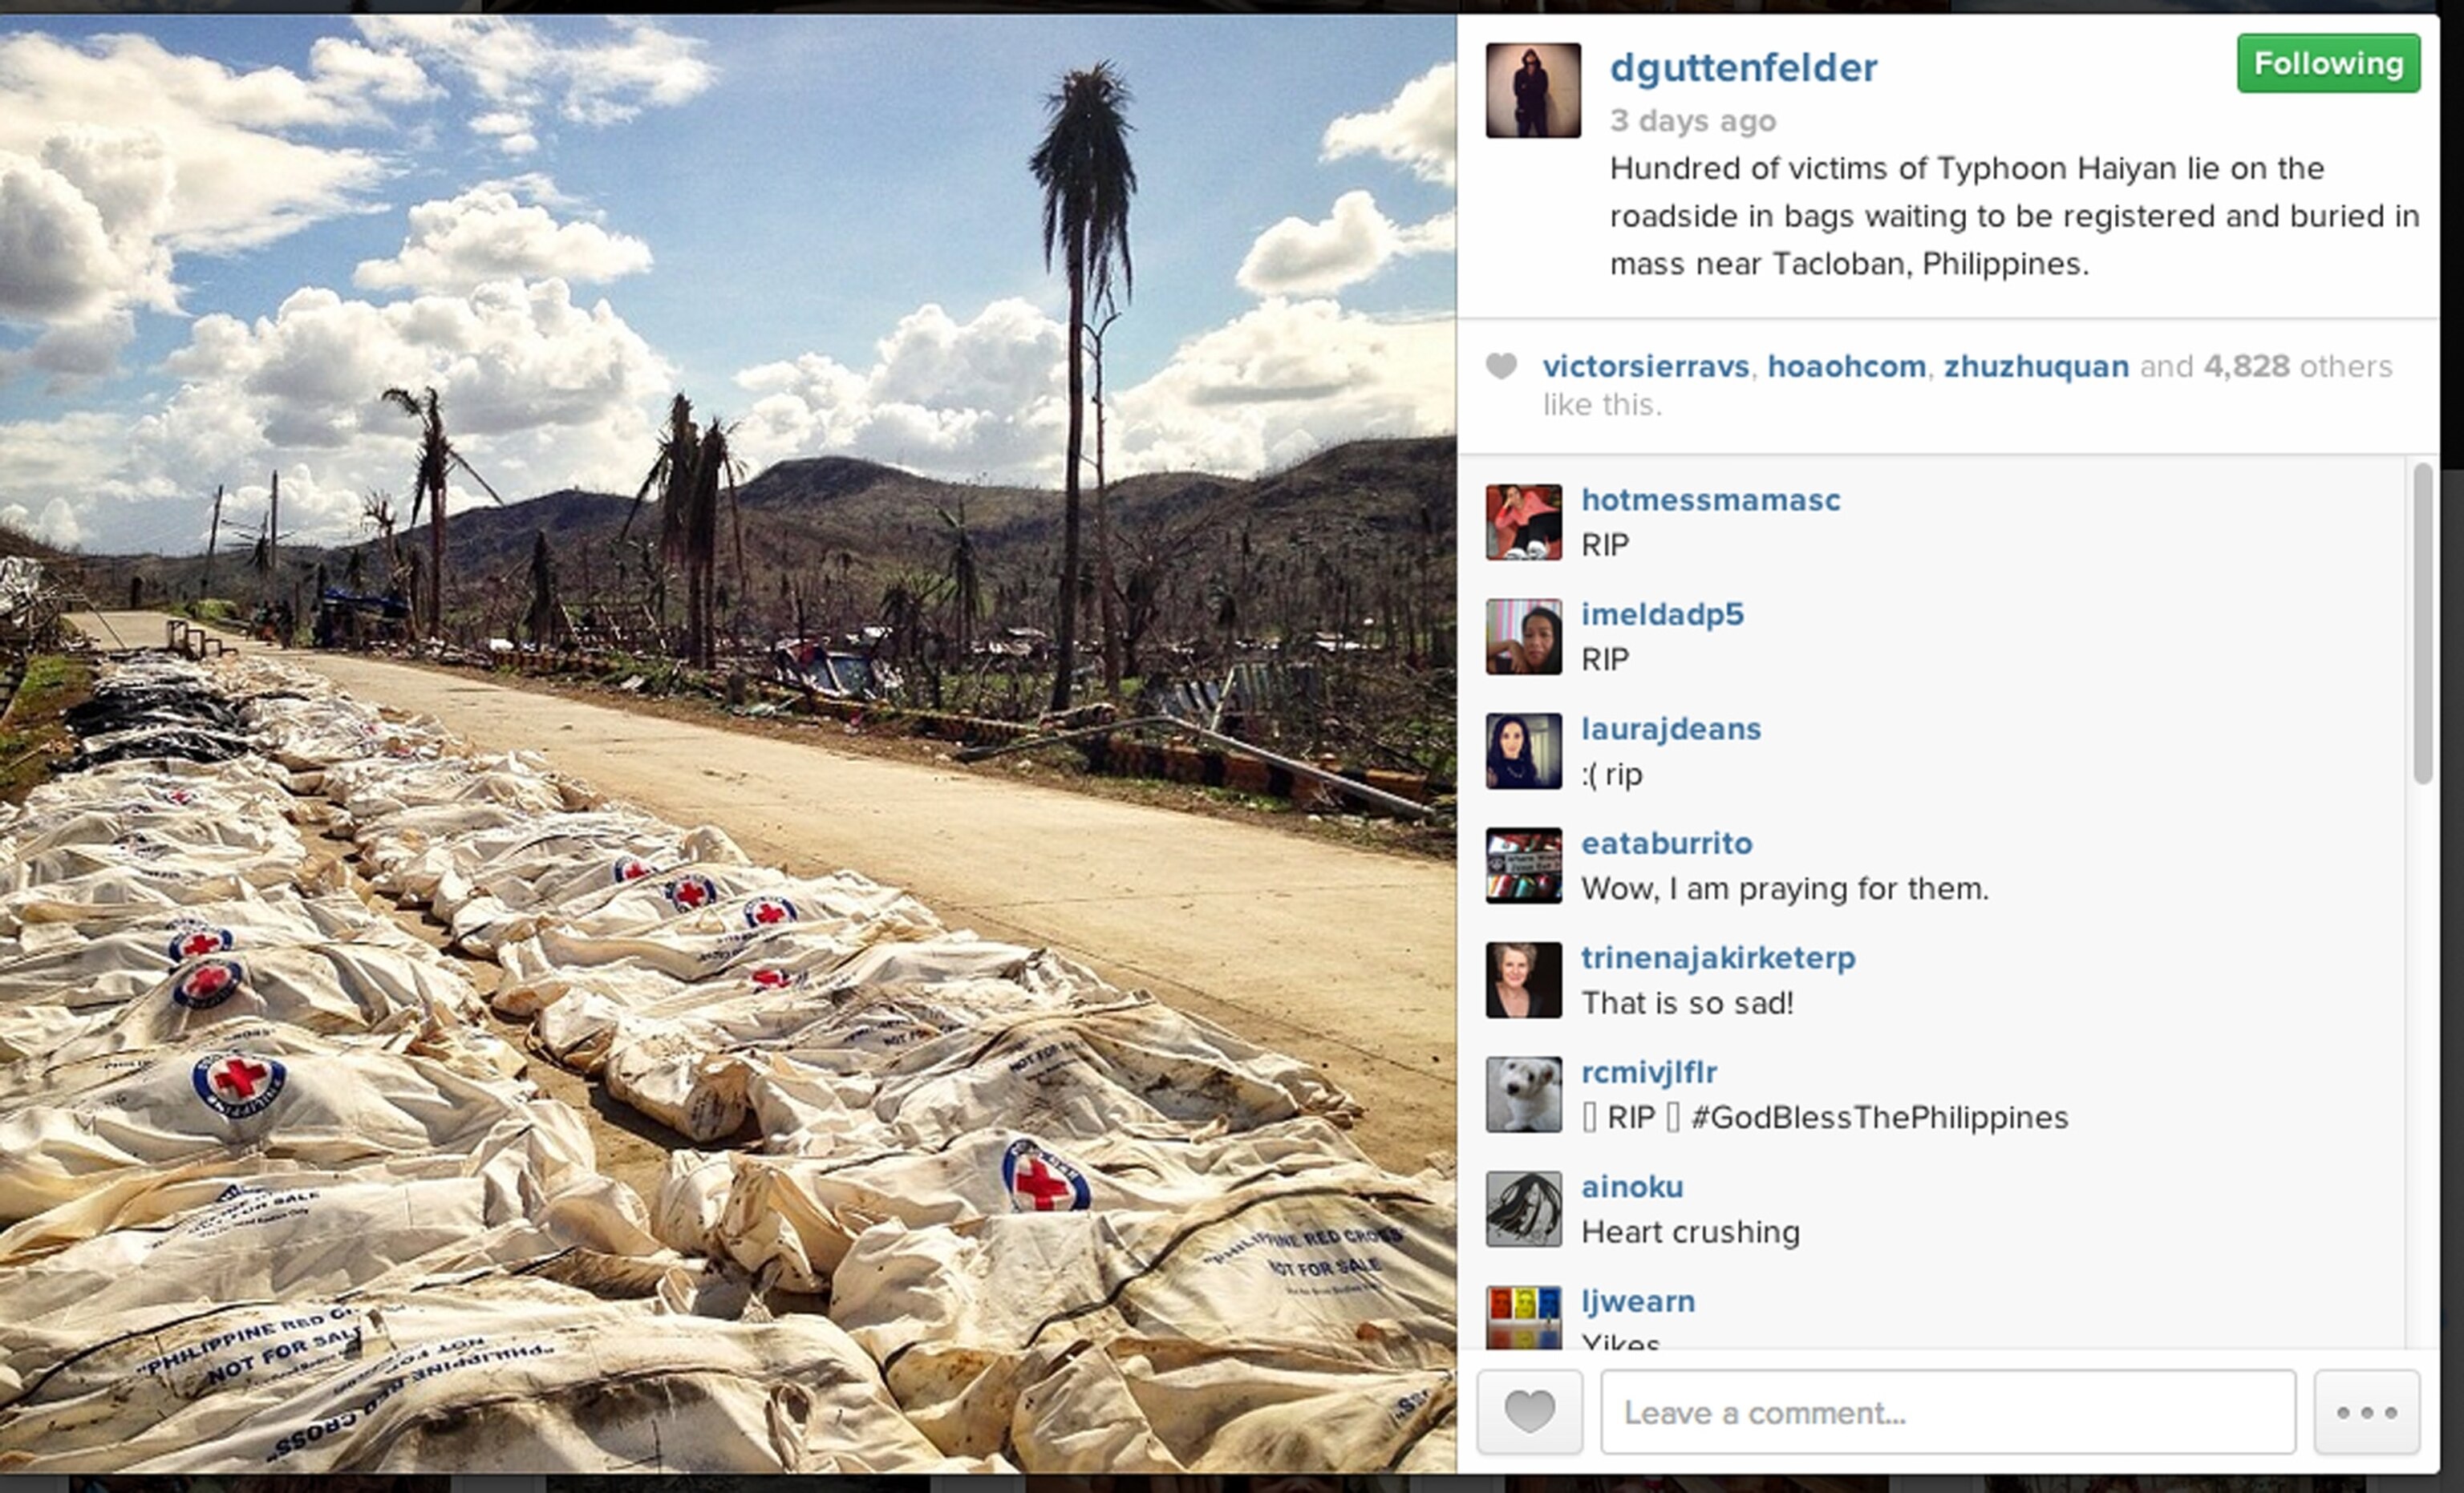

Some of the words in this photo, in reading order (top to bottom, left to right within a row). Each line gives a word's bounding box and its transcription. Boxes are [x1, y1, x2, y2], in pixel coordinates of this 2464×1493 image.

[1611, 51, 1878, 91] dguttenfelder
[2256, 51, 2403, 80] Following
[1611, 108, 1628, 131] 3
[1639, 109, 1708, 138] days
[1721, 115, 1777, 138] ago
[1611, 156, 1740, 180] Hundred
[1751, 155, 1781, 180] of
[1789, 156, 1887, 180] victims
[1899, 155, 1930, 180] of
[1937, 156, 2066, 187] Typhoon
[2079, 156, 2176, 187] Haiyan
[2189, 156, 2219, 180] lie
[2231, 161, 2267, 180] on
[2277, 156, 2324, 180] the
[1611, 203, 1738, 228] roadside
[1750, 204, 1773, 228] in
[1785, 203, 1854, 234] bags
[1865, 204, 1966, 234] waiting
[1977, 205, 2006, 228] to
[2017, 203, 2053, 228] be
[2065, 203, 2215, 234] registered
[2227, 203, 2279, 228] and
[2292, 203, 2384, 228] buried
[2397, 204, 2419, 228] in
[1611, 257, 1684, 275] mass
[1697, 257, 1762, 275] near
[1773, 251, 1913, 279] Tacloban,
[1924, 251, 2089, 281] Philippines.
[1542, 353, 1757, 381] victorsierravs,
[1769, 354, 1933, 381] hoaohcom,
[1944, 354, 2130, 384] zhuzhuquan
[2142, 354, 2192, 377] and
[2204, 354, 2290, 381] 4,828
[2301, 354, 2393, 377] others
[1546, 393, 1591, 415] like
[1603, 393, 1661, 415] this.
[1583, 487, 1841, 512] hotmessmamasc
[1583, 532, 1630, 556] RIP
[1583, 601, 1745, 633] imeldadp5
[1583, 646, 1630, 671] RIP
[1583, 715, 1761, 747] laurajdeans
[1607, 763, 1643, 792] rip
[1582, 830, 1753, 855] eataburrito
[1581, 876, 1660, 904] Wow,
[1672, 876, 1676, 900] I
[1688, 882, 1728, 900] am
[1741, 876, 1847, 907] praying
[1858, 876, 1899, 900] for
[1907, 876, 1988, 900] them.
[1581, 945, 1856, 976] trinenajakirketerp
[1582, 990, 1647, 1014] That
[1657, 991, 1677, 1014] is
[1690, 996, 1724, 1014] so
[1735, 990, 1793, 1014] sad!
[1583, 1059, 1718, 1090] rcmivjlflr
[1609, 1104, 1656, 1129] RIP
[1692, 1104, 2069, 1135] #GodBlessThePhilippines
[1582, 1174, 1684, 1198] ainoku
[1303, 1230, 1340, 1247] RED
[1583, 1220, 1664, 1244] Heart
[1672, 1219, 1799, 1250] crushing
[1299, 1260, 1334, 1277] FOR
[1335, 1256, 1383, 1275] SALE
[1583, 1288, 1695, 1319] ljwearn
[207, 1357, 254, 1385] NOT
[262, 1340, 308, 1365] FOR
[1626, 1400, 1712, 1425] Leave
[1722, 1406, 1739, 1425] a
